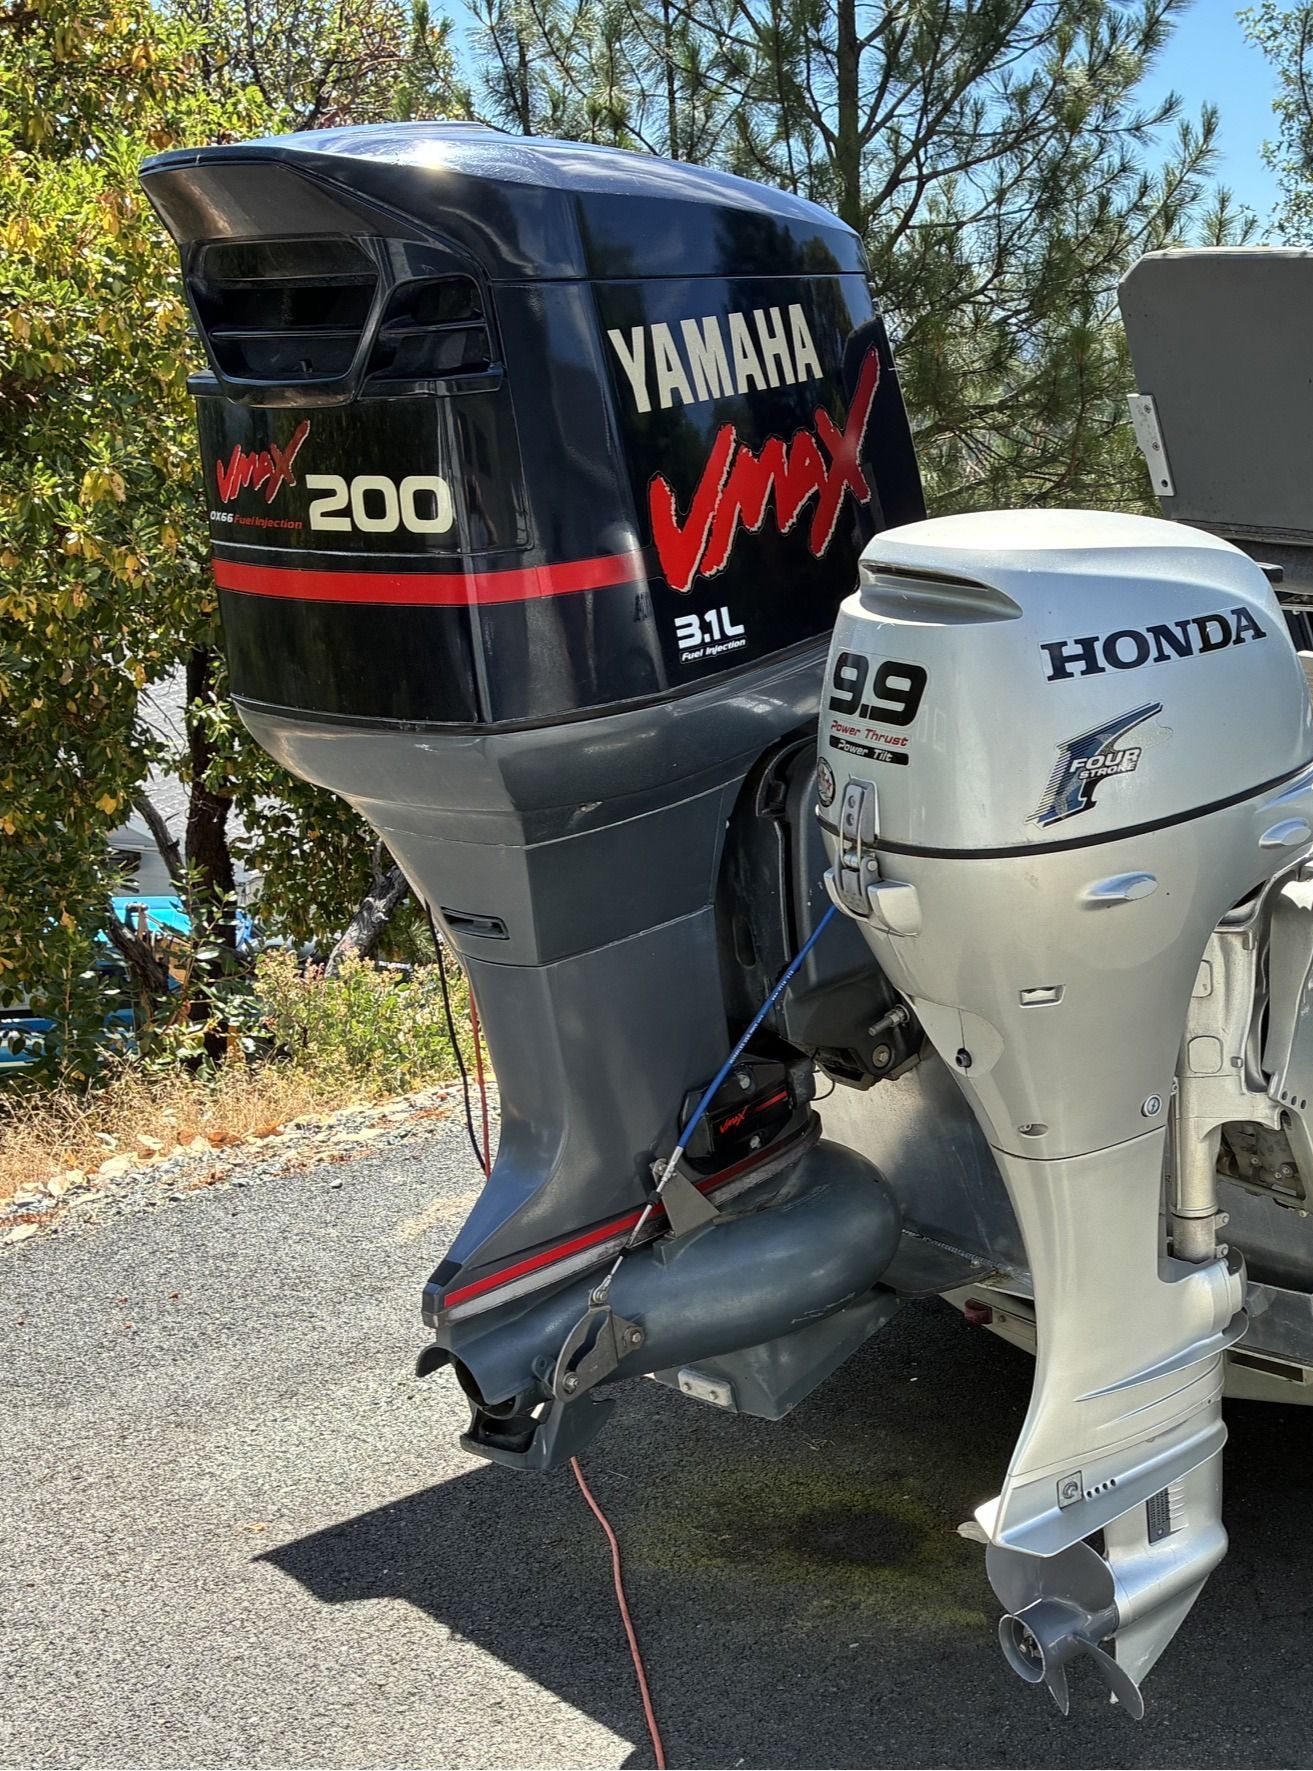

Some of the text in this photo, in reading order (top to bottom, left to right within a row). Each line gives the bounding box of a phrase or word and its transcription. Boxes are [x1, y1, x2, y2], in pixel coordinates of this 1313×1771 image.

[607, 303, 824, 413] YAMAHA
[305, 474, 454, 534] 200
[674, 606, 745, 650] 3.1L
[1040, 606, 1267, 681] HONDA
[681, 639, 746, 661] Fuel Injection
[829, 652, 927, 726] 9.9
[831, 719, 909, 747] Power Thrust
[837, 739, 893, 762] Power Tilt
[1069, 749, 1139, 773] FOUR
[1079, 762, 1136, 780] STROKE
